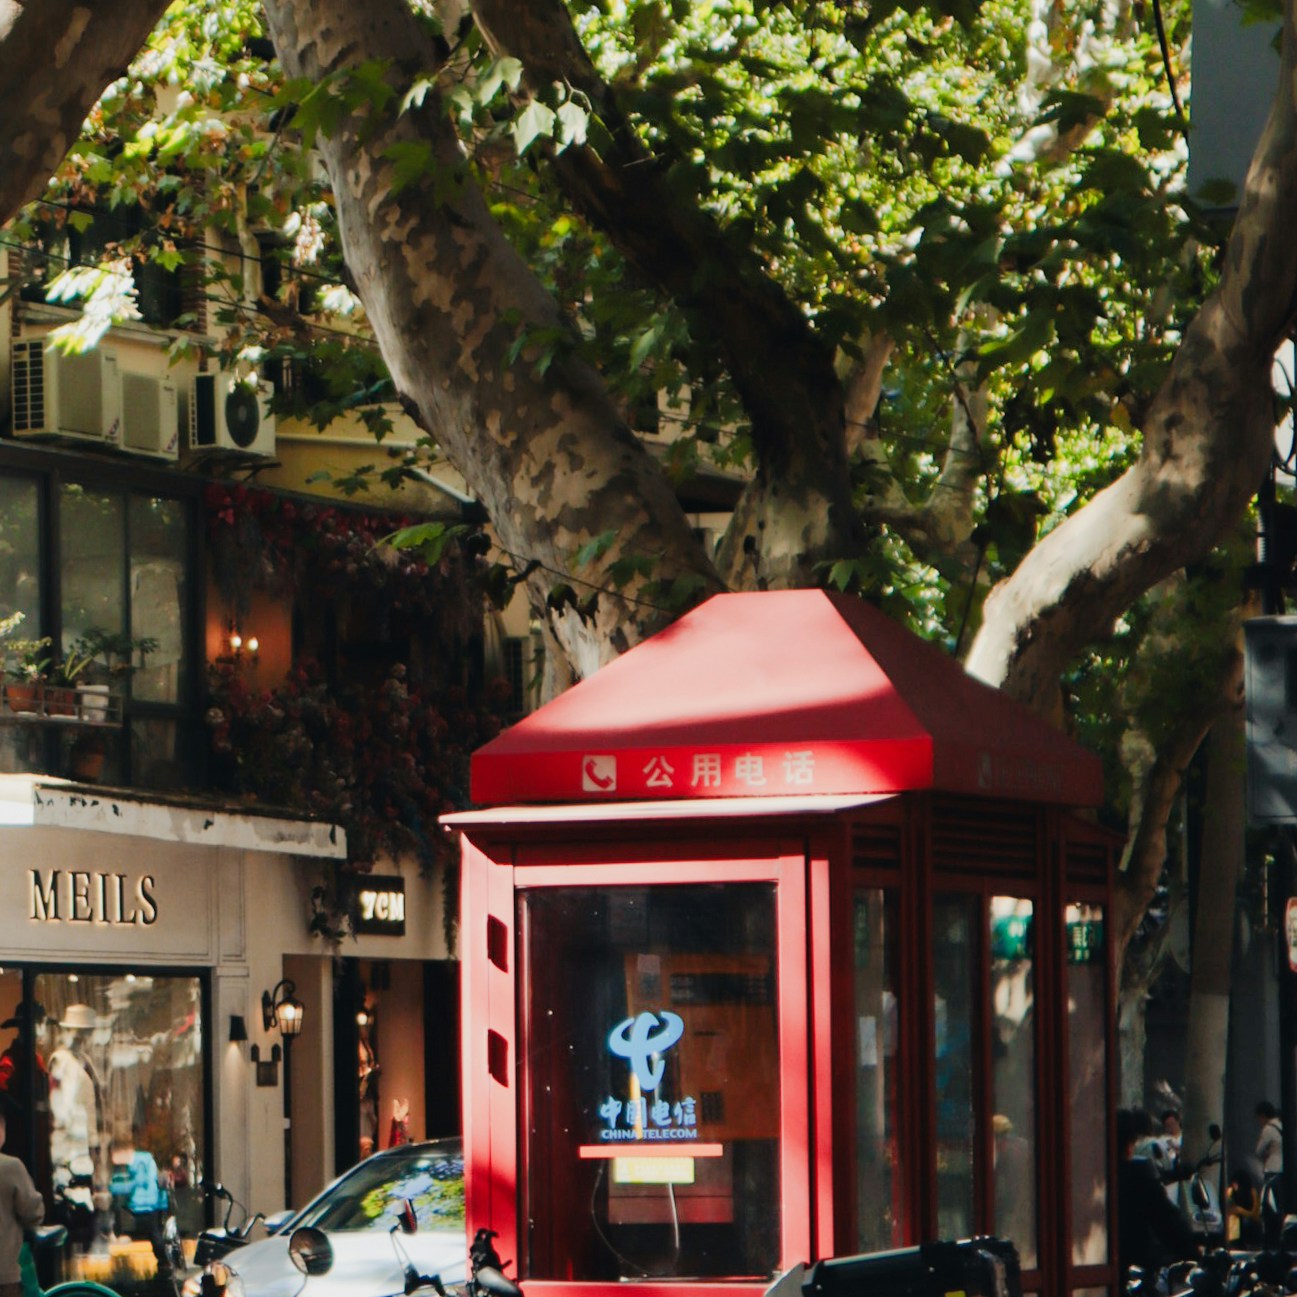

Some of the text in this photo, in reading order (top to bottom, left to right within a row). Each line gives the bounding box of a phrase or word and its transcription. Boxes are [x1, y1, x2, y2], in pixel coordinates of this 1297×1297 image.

[642, 751, 815, 788] 公用电话
[28, 868, 158, 925] MEILS
[600, 1095, 696, 1129] 中国电信
[601, 1128, 698, 1140] CHINA TELECOM
